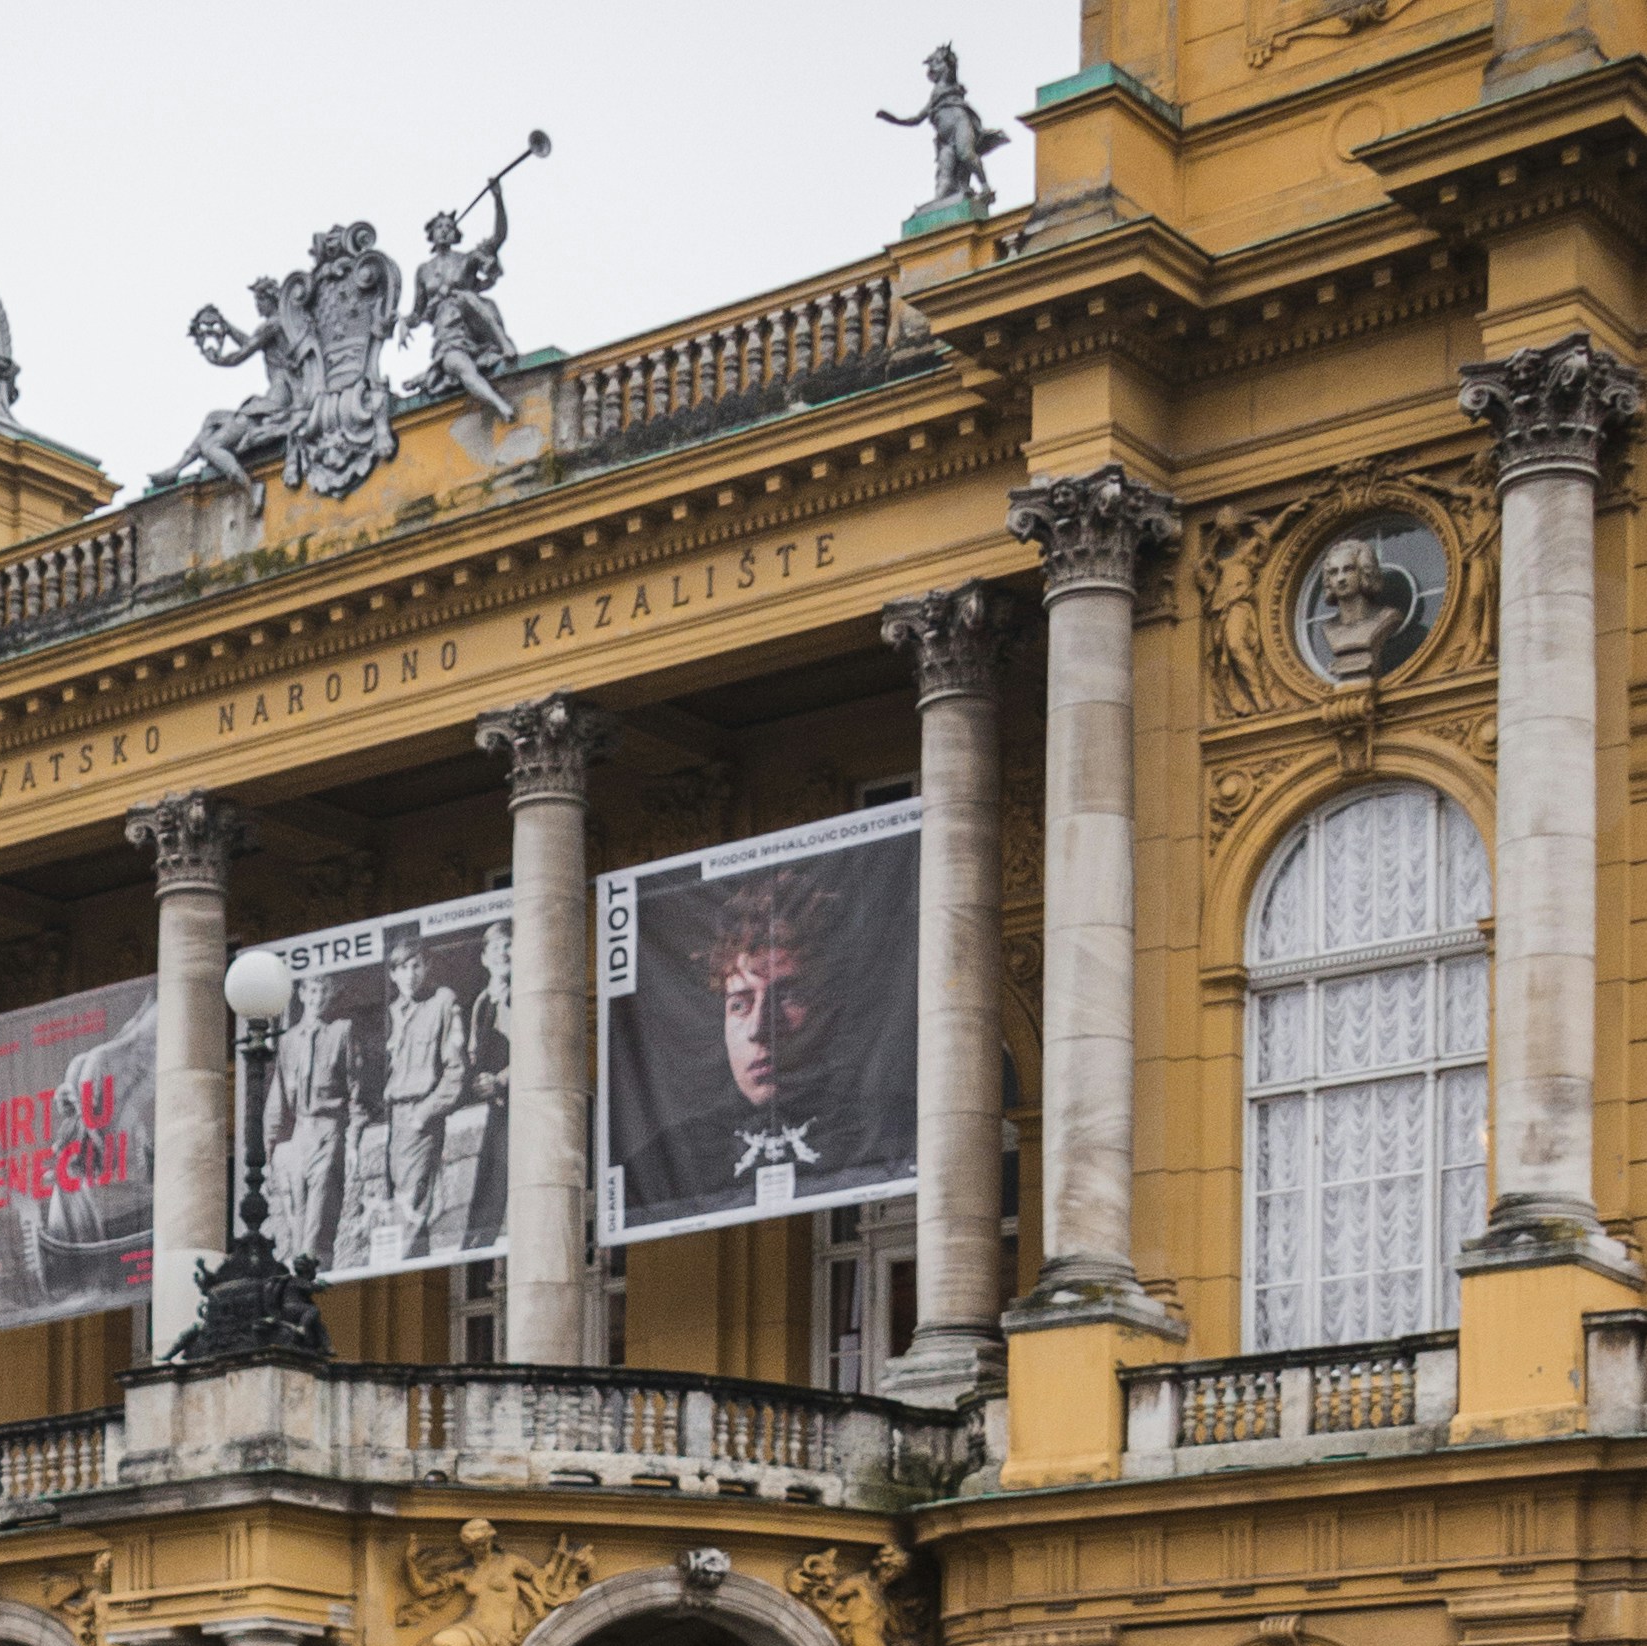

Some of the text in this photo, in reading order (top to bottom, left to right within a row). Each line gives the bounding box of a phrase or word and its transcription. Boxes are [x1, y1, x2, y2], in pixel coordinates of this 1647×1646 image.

[218, 641, 457, 734] NARODNO
[522, 533, 836, 650] KAZALIŠTE
[608, 881, 629, 983] IDIOT
[81, 1073, 114, 1130] U
